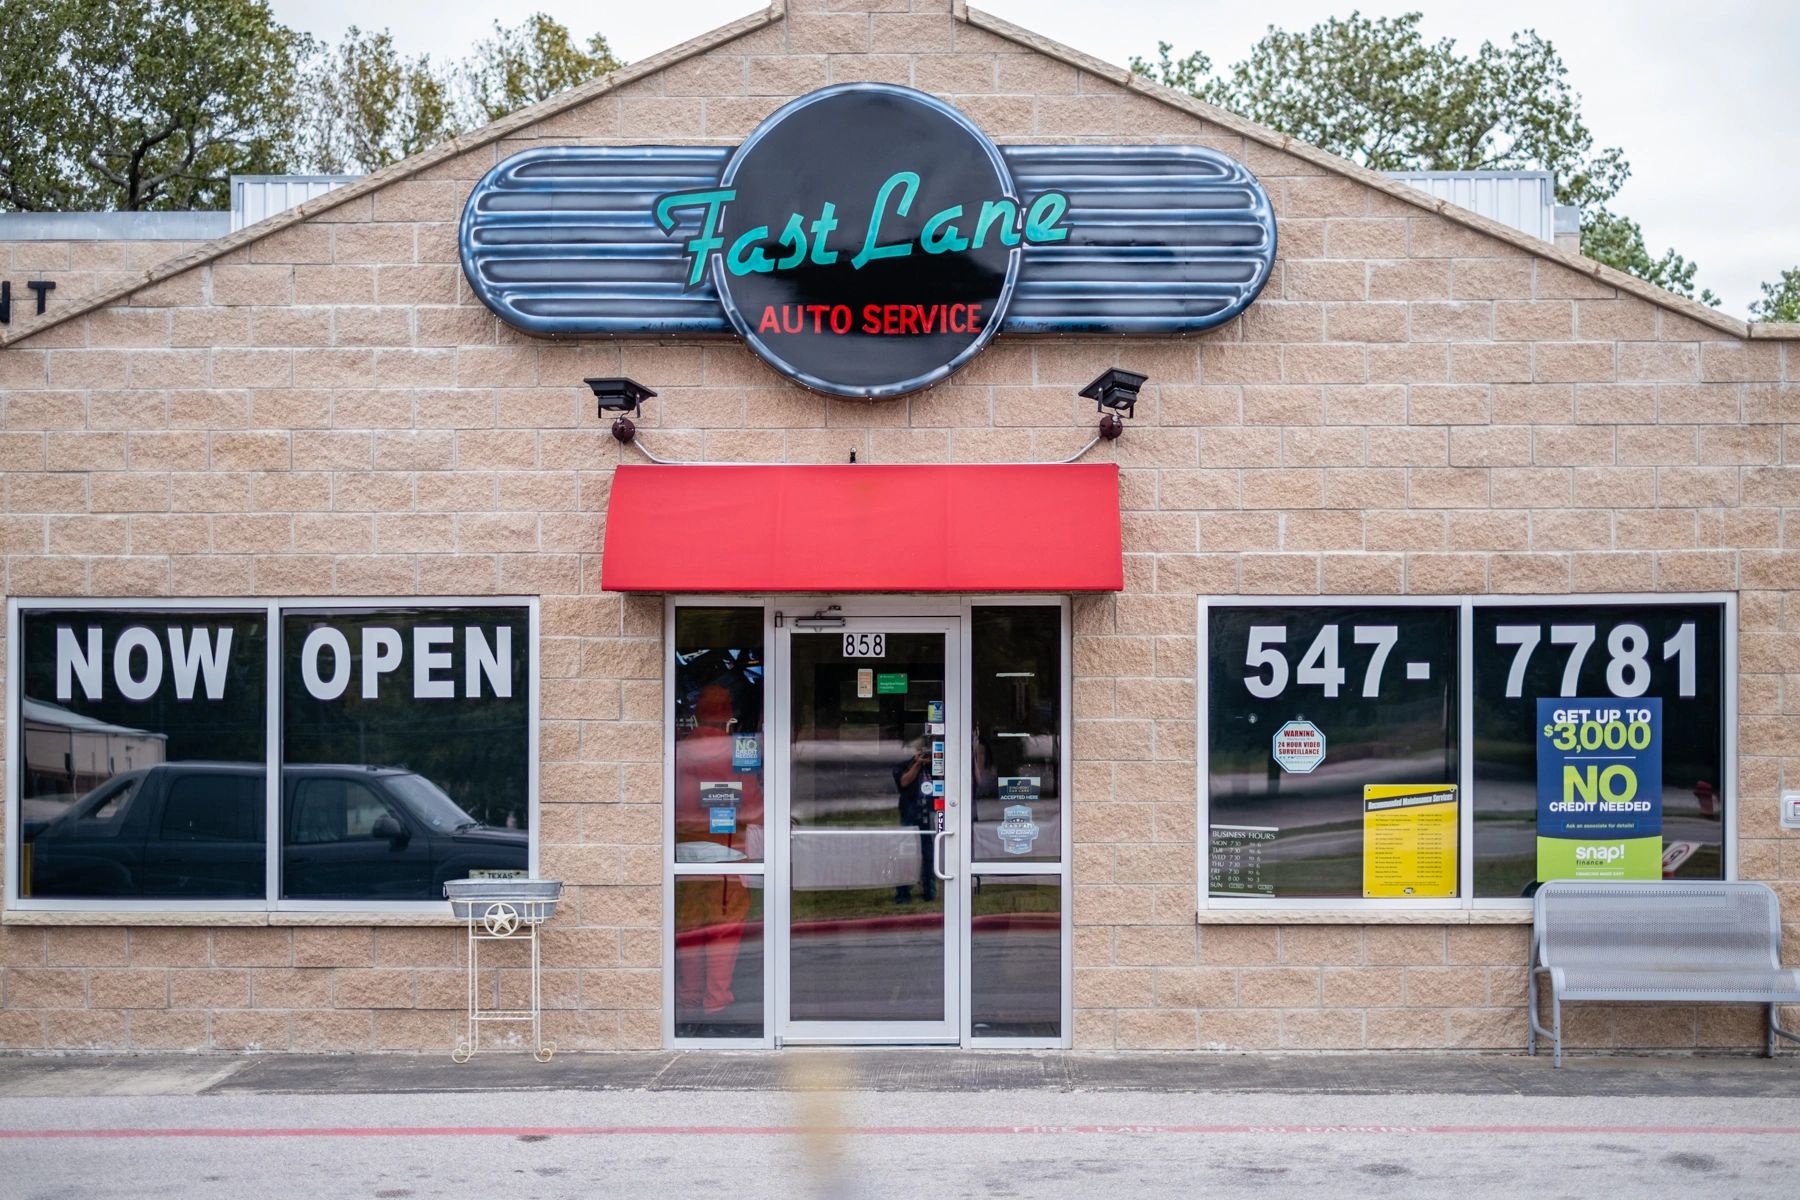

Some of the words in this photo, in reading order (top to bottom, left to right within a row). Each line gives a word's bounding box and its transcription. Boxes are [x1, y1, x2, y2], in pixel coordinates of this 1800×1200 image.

[656, 189, 839, 287] Fast
[851, 171, 1070, 270] Lane
[758, 304, 852, 334] AUTO
[861, 304, 982, 334] SERVICE
[845, 634, 883, 656] 858
[57, 627, 234, 700] NOW
[301, 626, 512, 700] OPEN
[1553, 709, 1590, 724] GET
[1596, 710, 1621, 724] UP
[1626, 709, 1651, 724] TO
[736, 740, 758, 750] NO
[1544, 720, 1652, 753] $3,000
[1563, 764, 1638, 804] NO
[1432, 794, 1453, 802] Services
[1549, 802, 1596, 812] CREDIT
[1599, 802, 1652, 812] NEEDED
[1576, 844, 1624, 862] snap!
